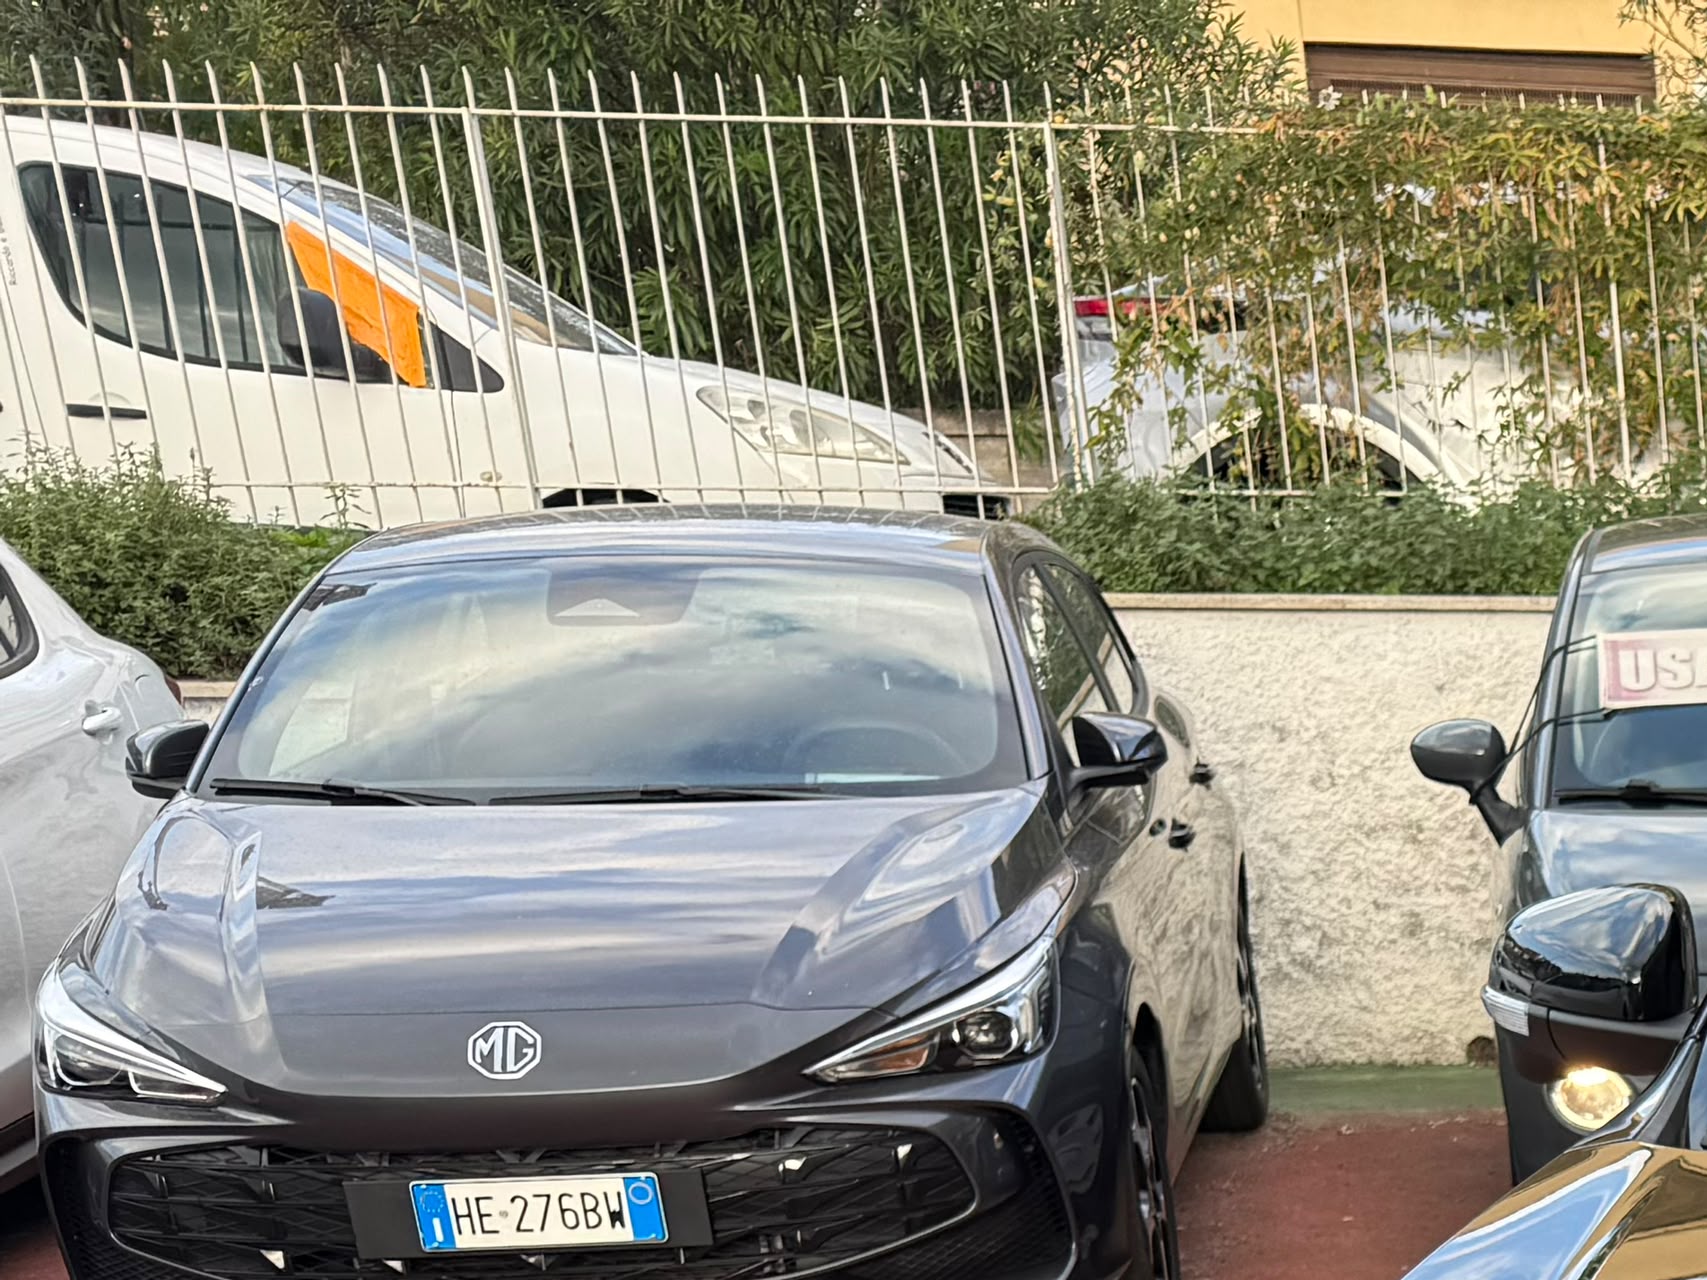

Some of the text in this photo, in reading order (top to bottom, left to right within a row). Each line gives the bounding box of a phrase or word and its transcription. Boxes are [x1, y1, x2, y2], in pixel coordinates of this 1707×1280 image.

[474, 1026, 535, 1073] MG
[432, 1190, 627, 1242] I HE 276BW
